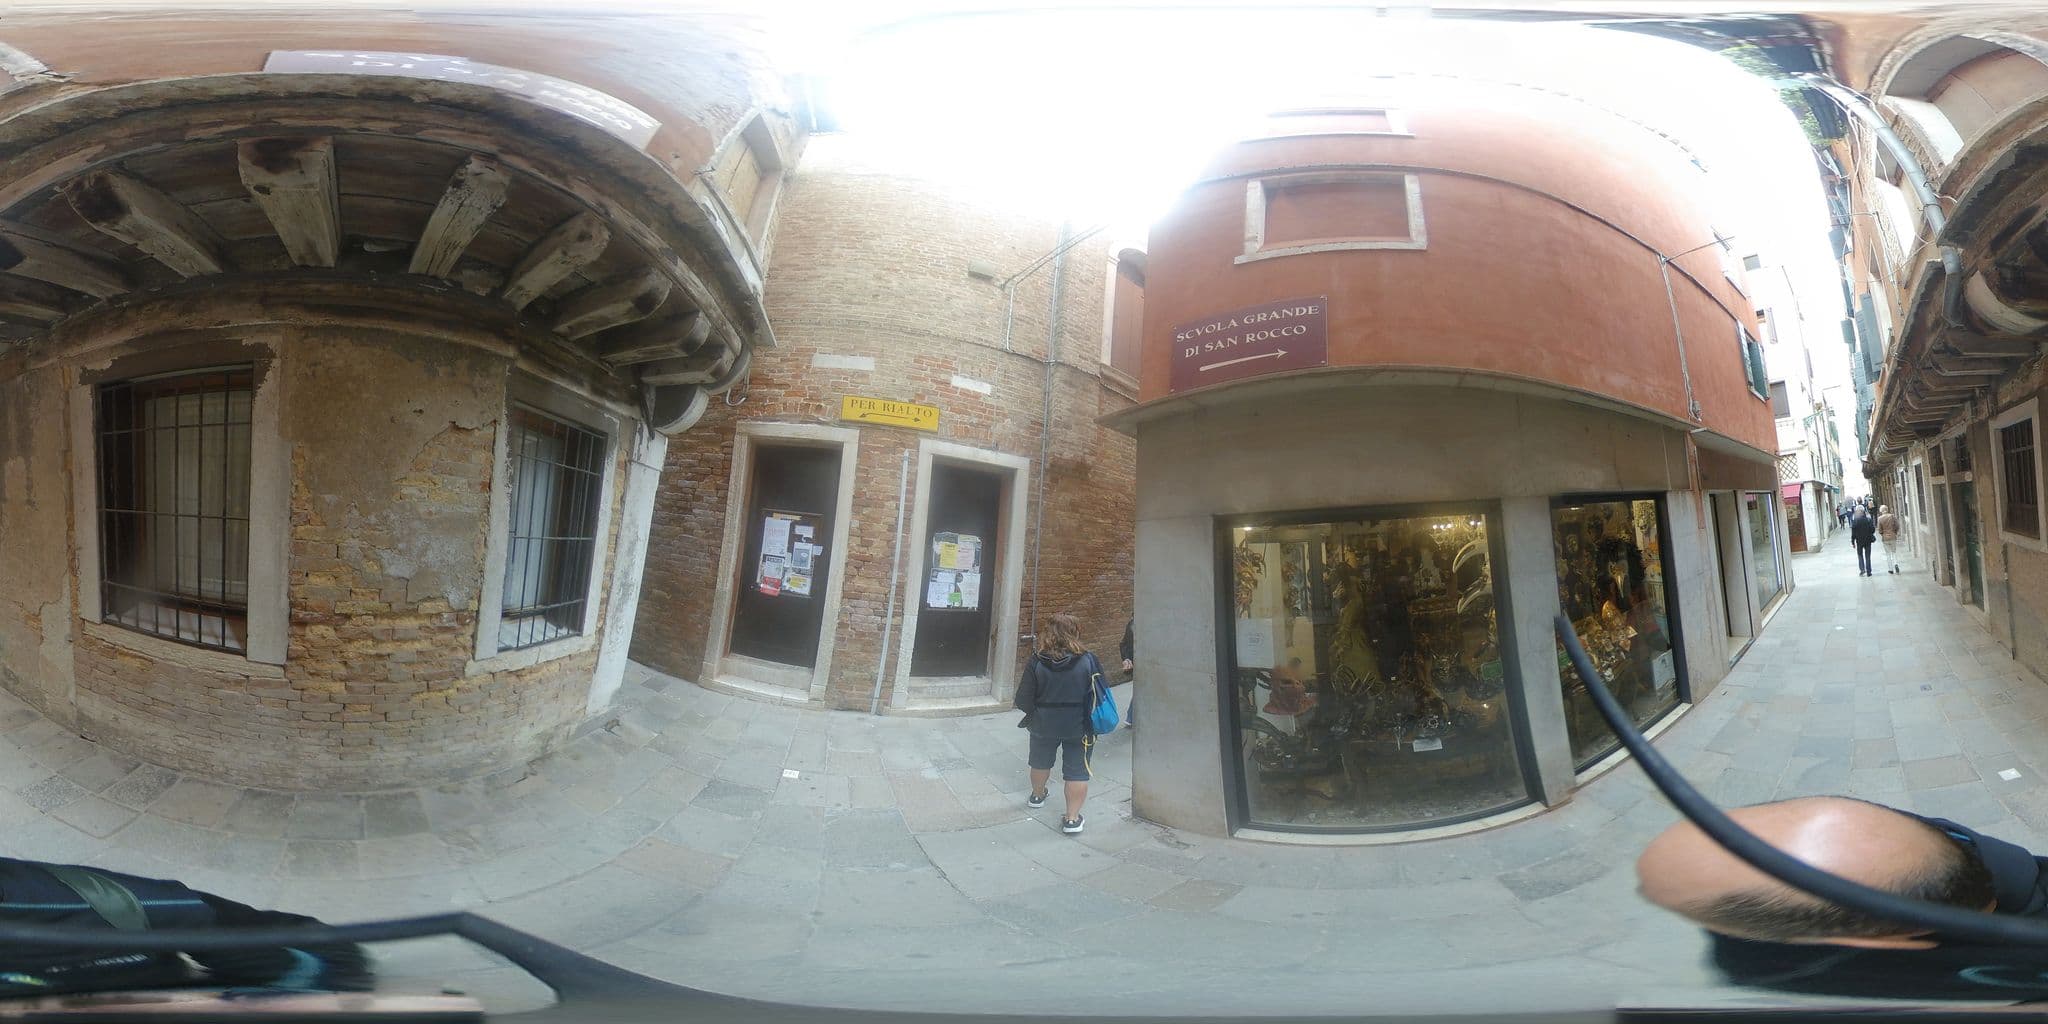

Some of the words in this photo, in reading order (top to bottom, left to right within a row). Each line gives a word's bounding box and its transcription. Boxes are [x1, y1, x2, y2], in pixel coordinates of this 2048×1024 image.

[1176, 318, 1239, 343] SCVOLA
[1243, 305, 1320, 325] GRANDE
[1185, 345, 1200, 358] DI
[1204, 336, 1239, 353] SAN
[1245, 325, 1307, 344] ROCCO
[850, 398, 876, 411] PER
[882, 401, 933, 418] RIALTO
